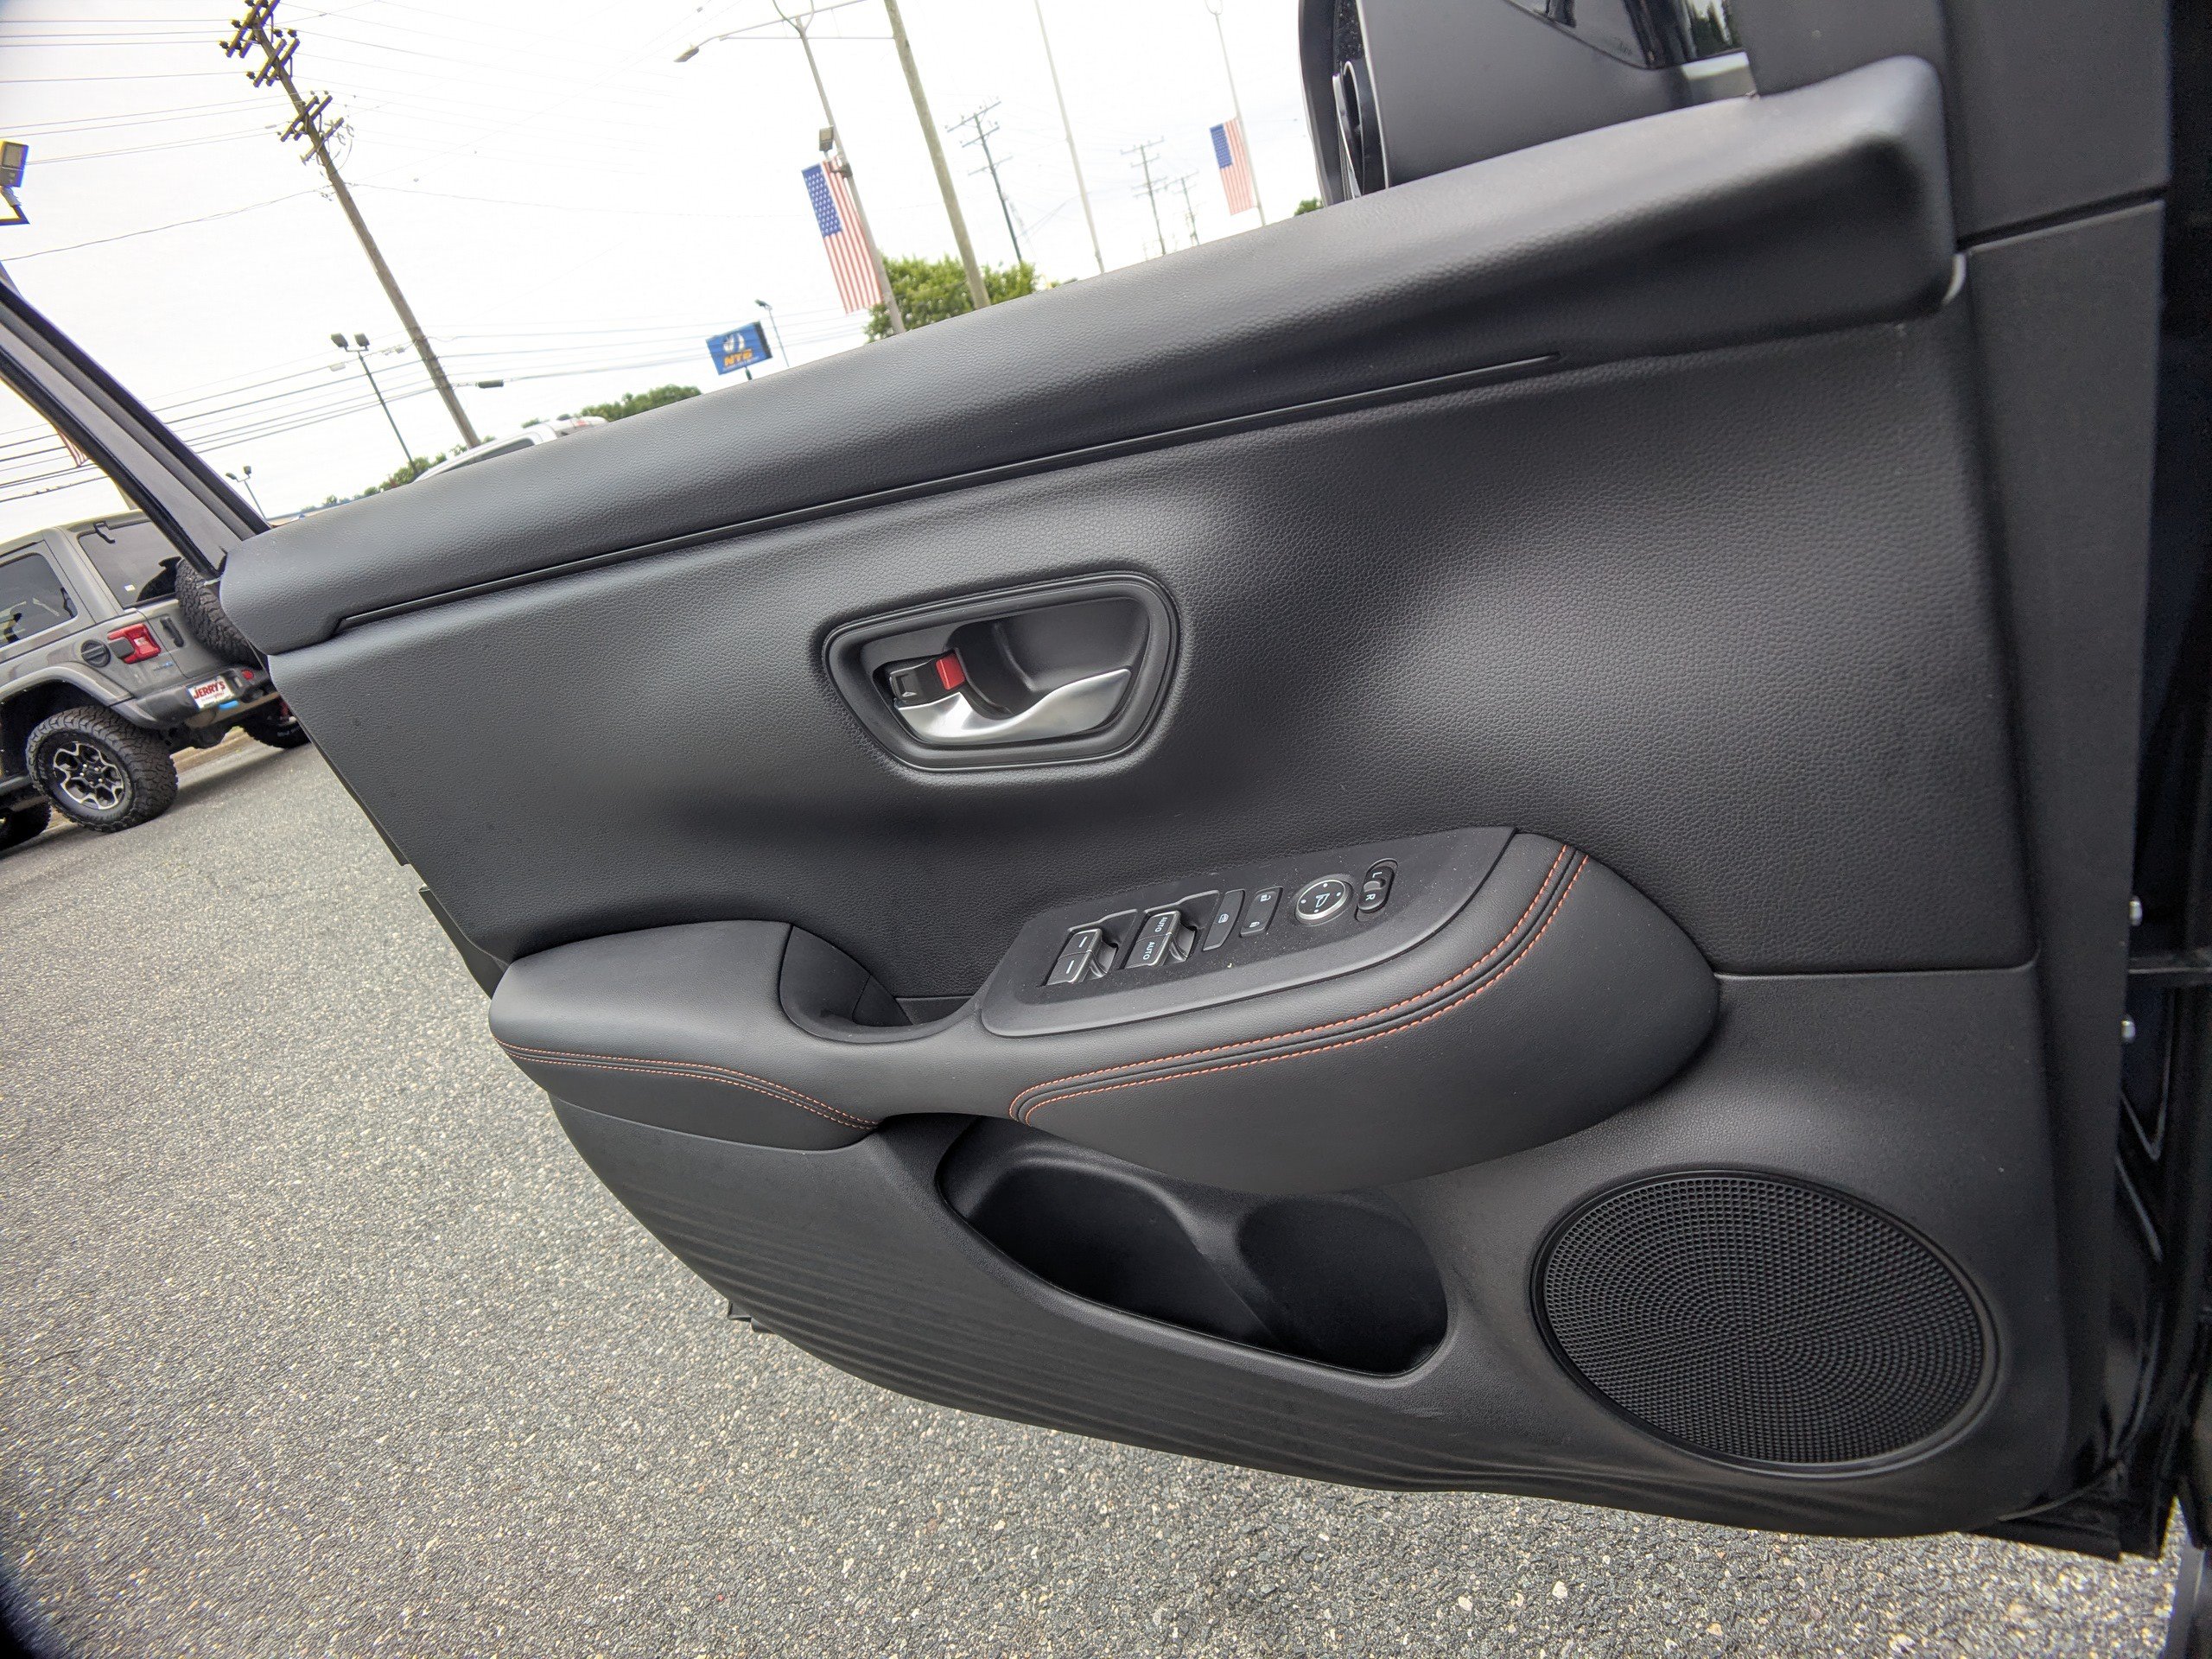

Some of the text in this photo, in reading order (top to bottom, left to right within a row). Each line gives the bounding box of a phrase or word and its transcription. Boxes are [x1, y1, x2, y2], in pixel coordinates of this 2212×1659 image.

[194, 681, 226, 699] JERRY'S
[1154, 917, 1167, 932] AUTO
[1142, 942, 1155, 960] AUTO
